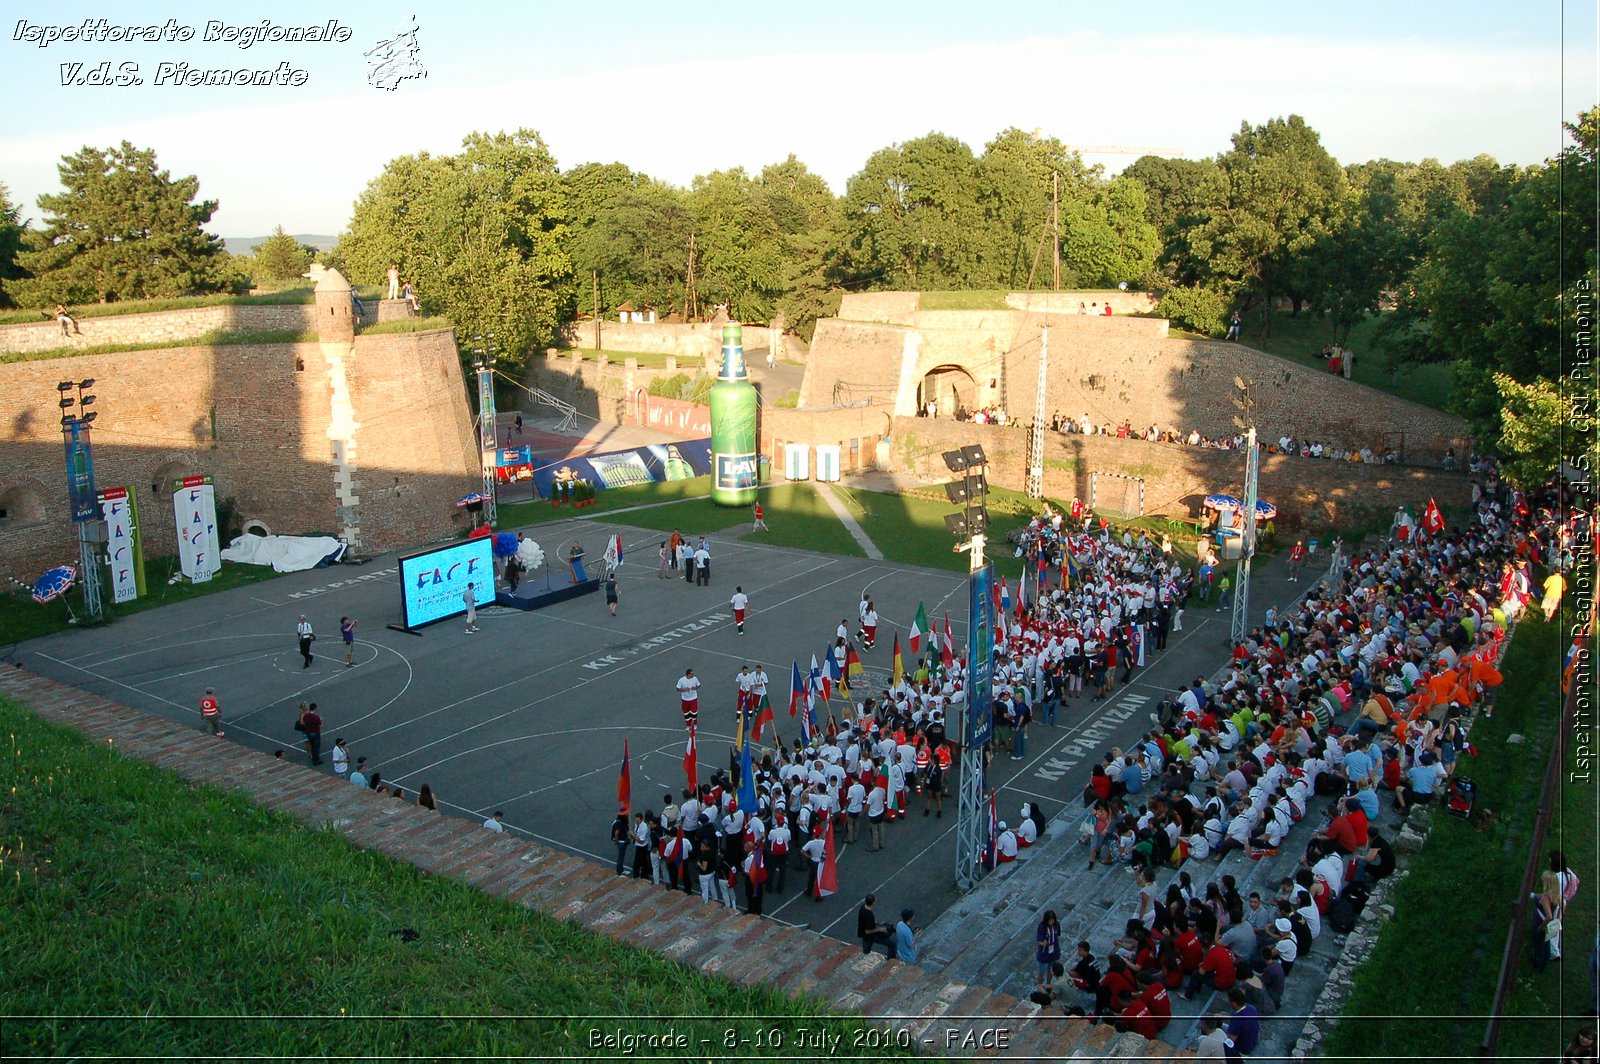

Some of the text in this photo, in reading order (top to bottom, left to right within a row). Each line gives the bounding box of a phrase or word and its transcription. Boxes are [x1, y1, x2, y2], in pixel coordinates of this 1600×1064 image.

[117, 586, 135, 598] 2010
[582, 654, 626, 670] KK
[1033, 693, 1151, 782] KK PARTIZAN
